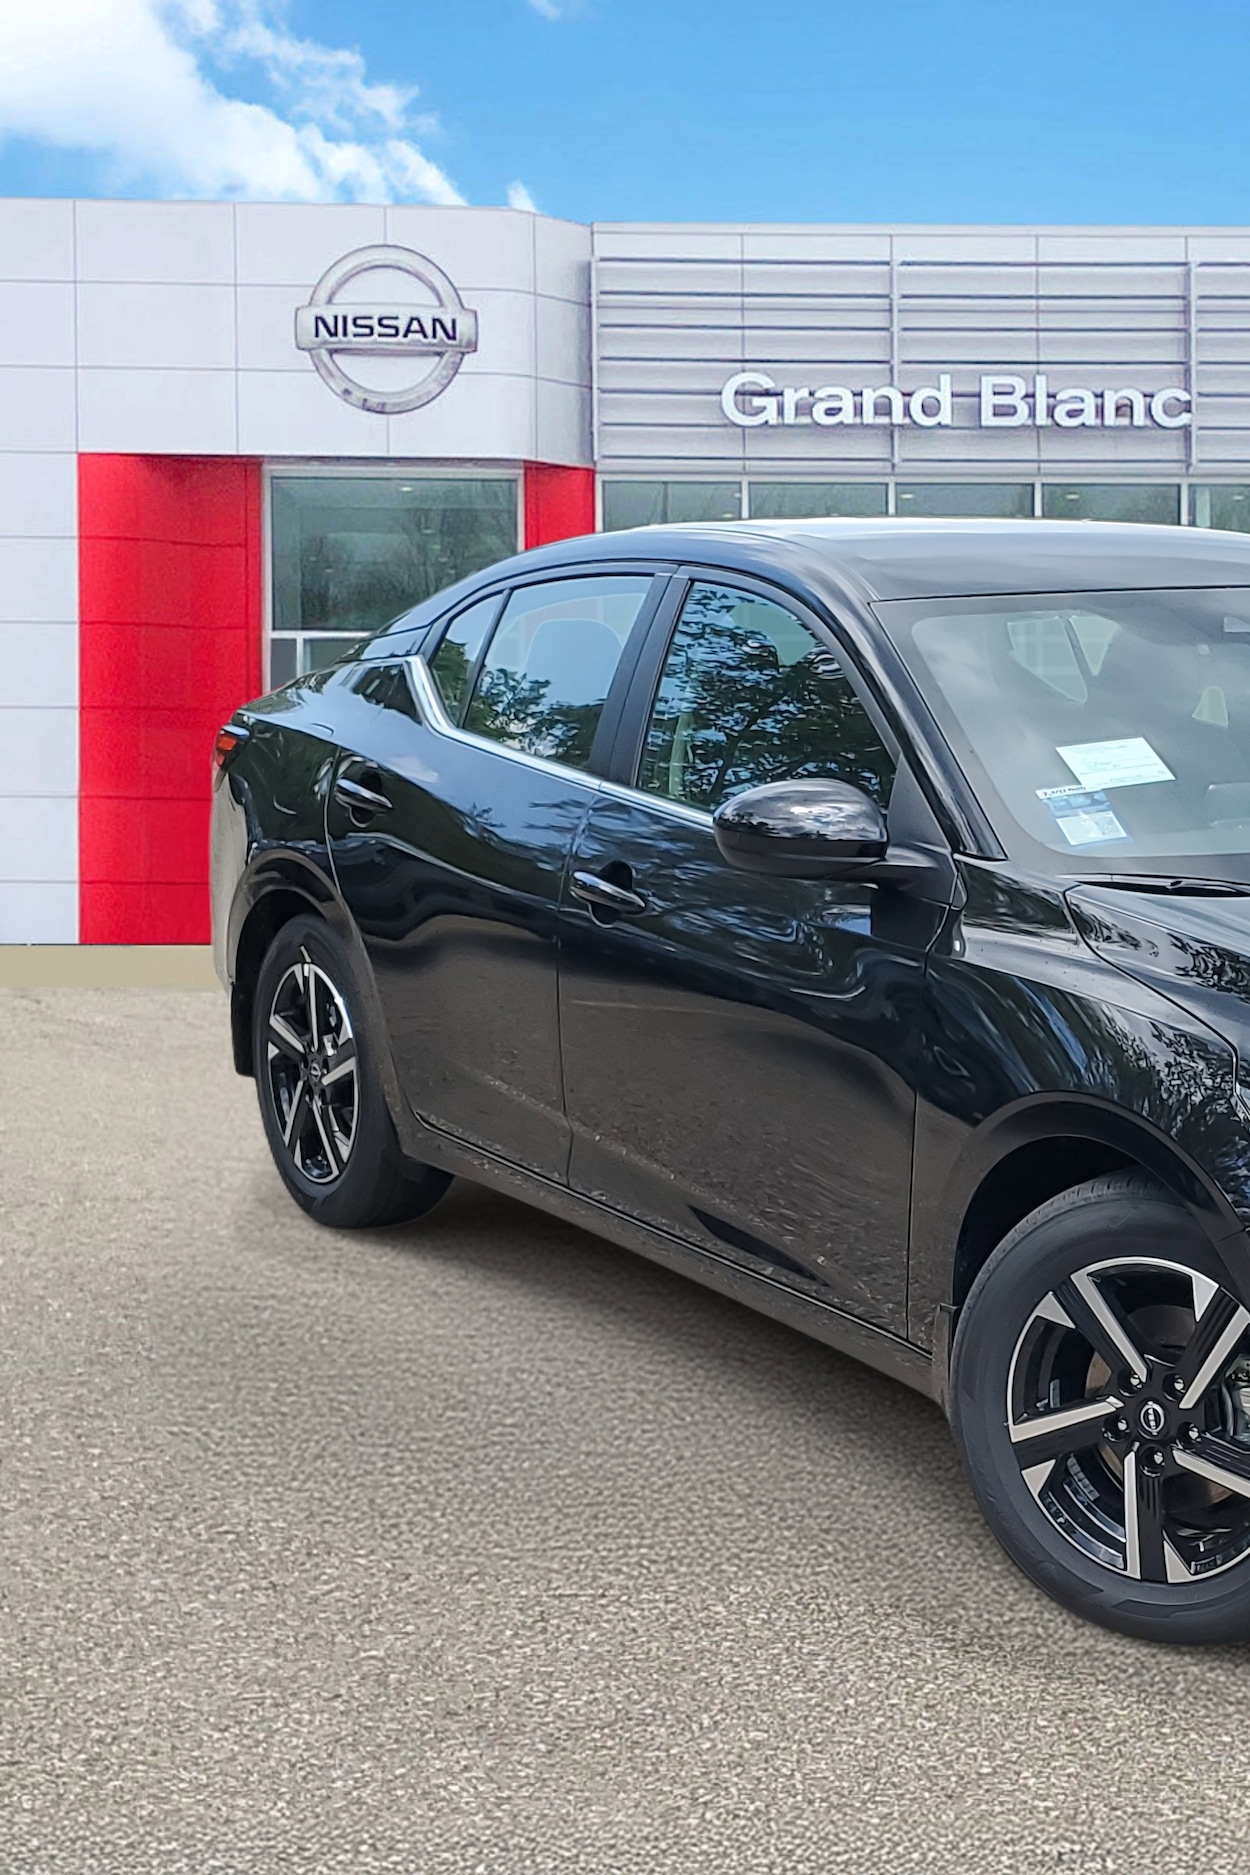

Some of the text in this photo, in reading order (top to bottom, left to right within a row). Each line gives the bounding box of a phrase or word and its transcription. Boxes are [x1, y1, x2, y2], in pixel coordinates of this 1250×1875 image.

[314, 315, 457, 341] NISSAN
[721, 371, 1193, 429] Grand Blanc
